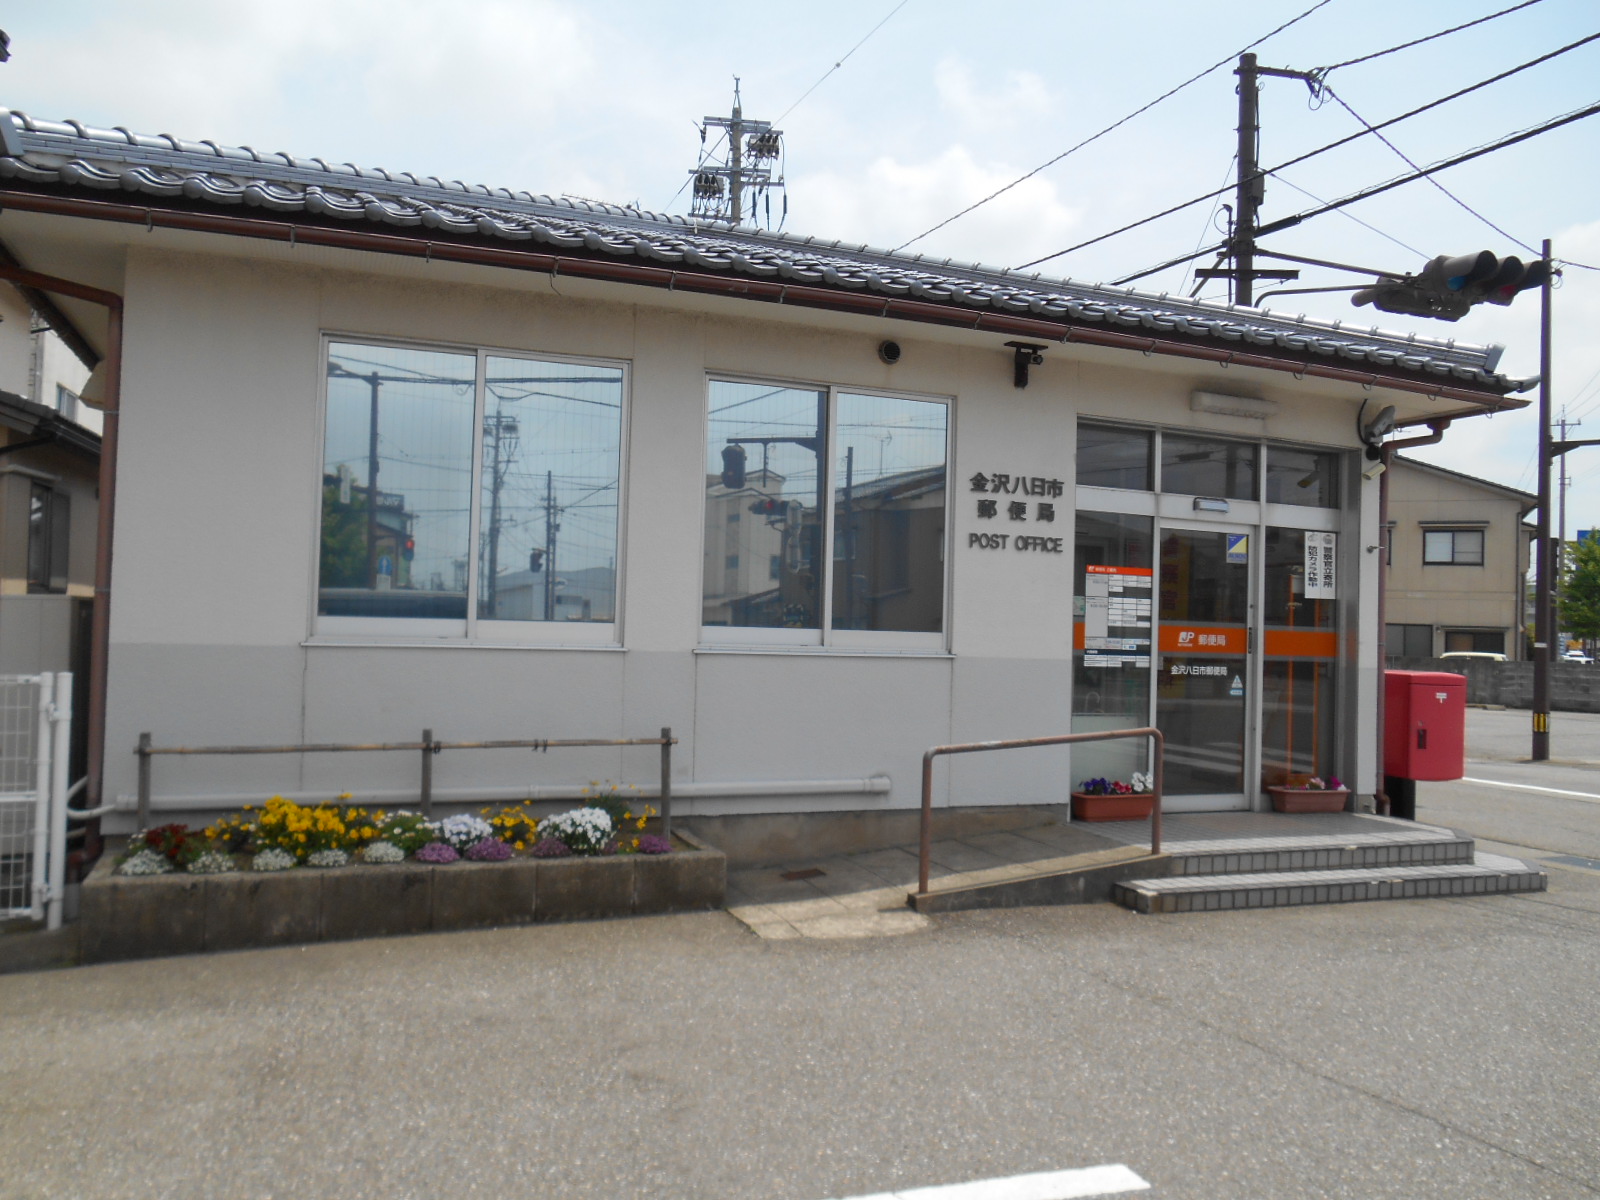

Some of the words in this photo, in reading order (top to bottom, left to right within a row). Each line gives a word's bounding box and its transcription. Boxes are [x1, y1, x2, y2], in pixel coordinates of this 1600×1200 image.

[969, 472, 1065, 498] 金沢八日市
[977, 499, 1055, 523] 郵便局
[969, 533, 1010, 550] POST
[1014, 535, 1063, 553] OFFICE
[1198, 634, 1226, 647] 郵便局
[1171, 664, 1228, 677] 金沢八日市郵便局
